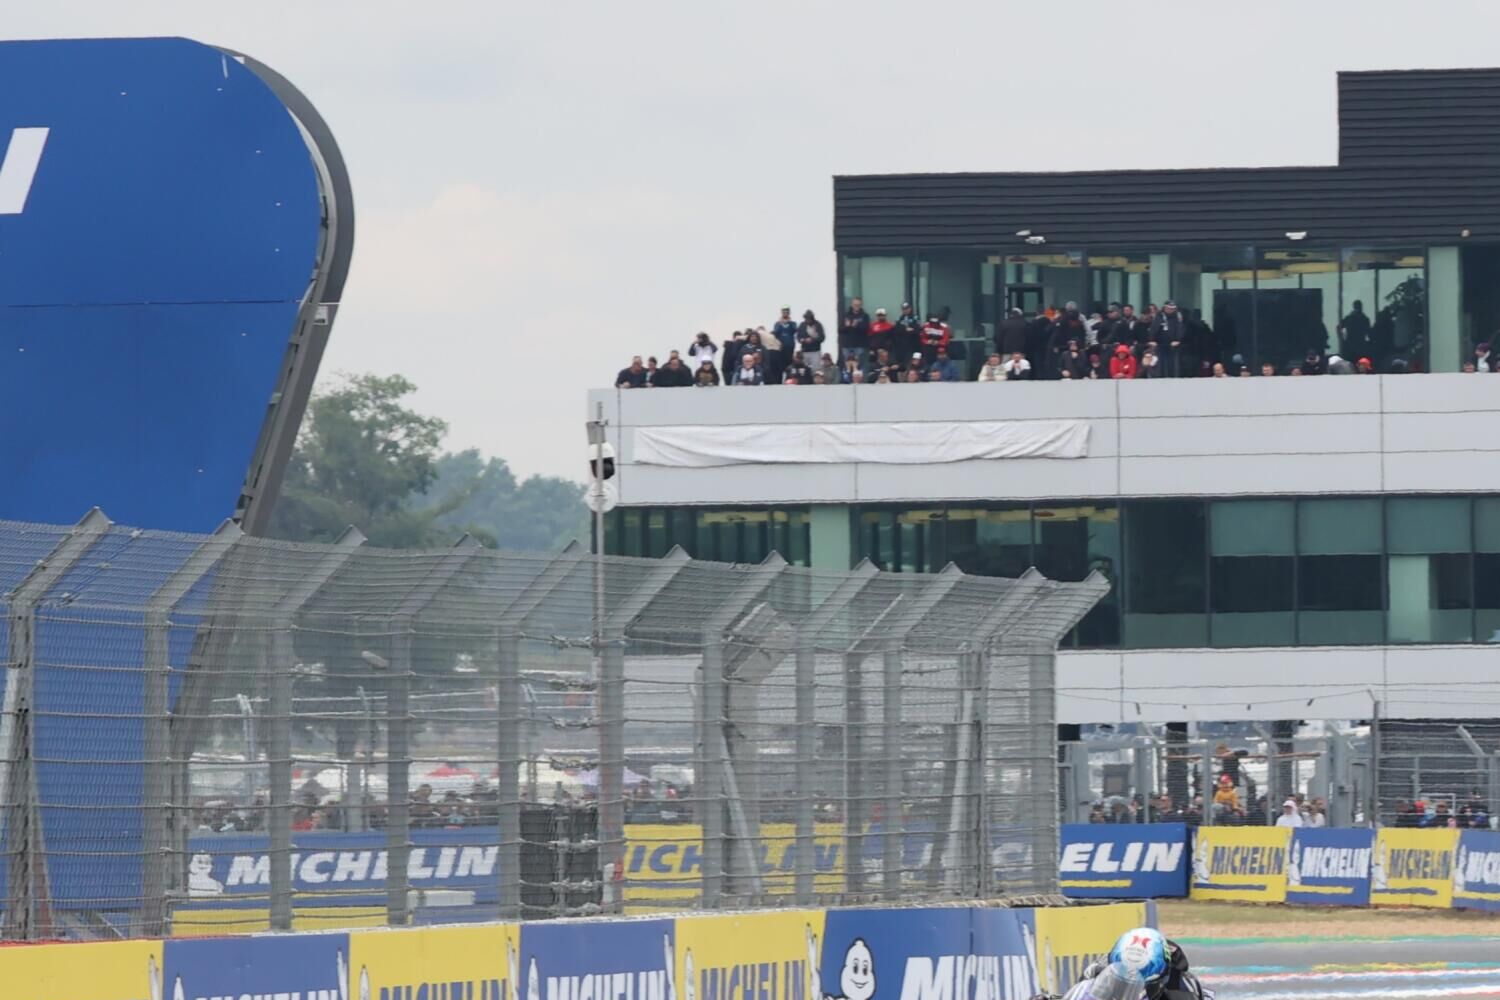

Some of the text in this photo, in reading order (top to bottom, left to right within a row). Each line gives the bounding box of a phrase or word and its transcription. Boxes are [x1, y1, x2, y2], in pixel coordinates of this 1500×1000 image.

[1210, 846, 1285, 875] MICHELIN
[1302, 847, 1371, 878] MICHELIN
[1388, 849, 1449, 879] MICHELIN
